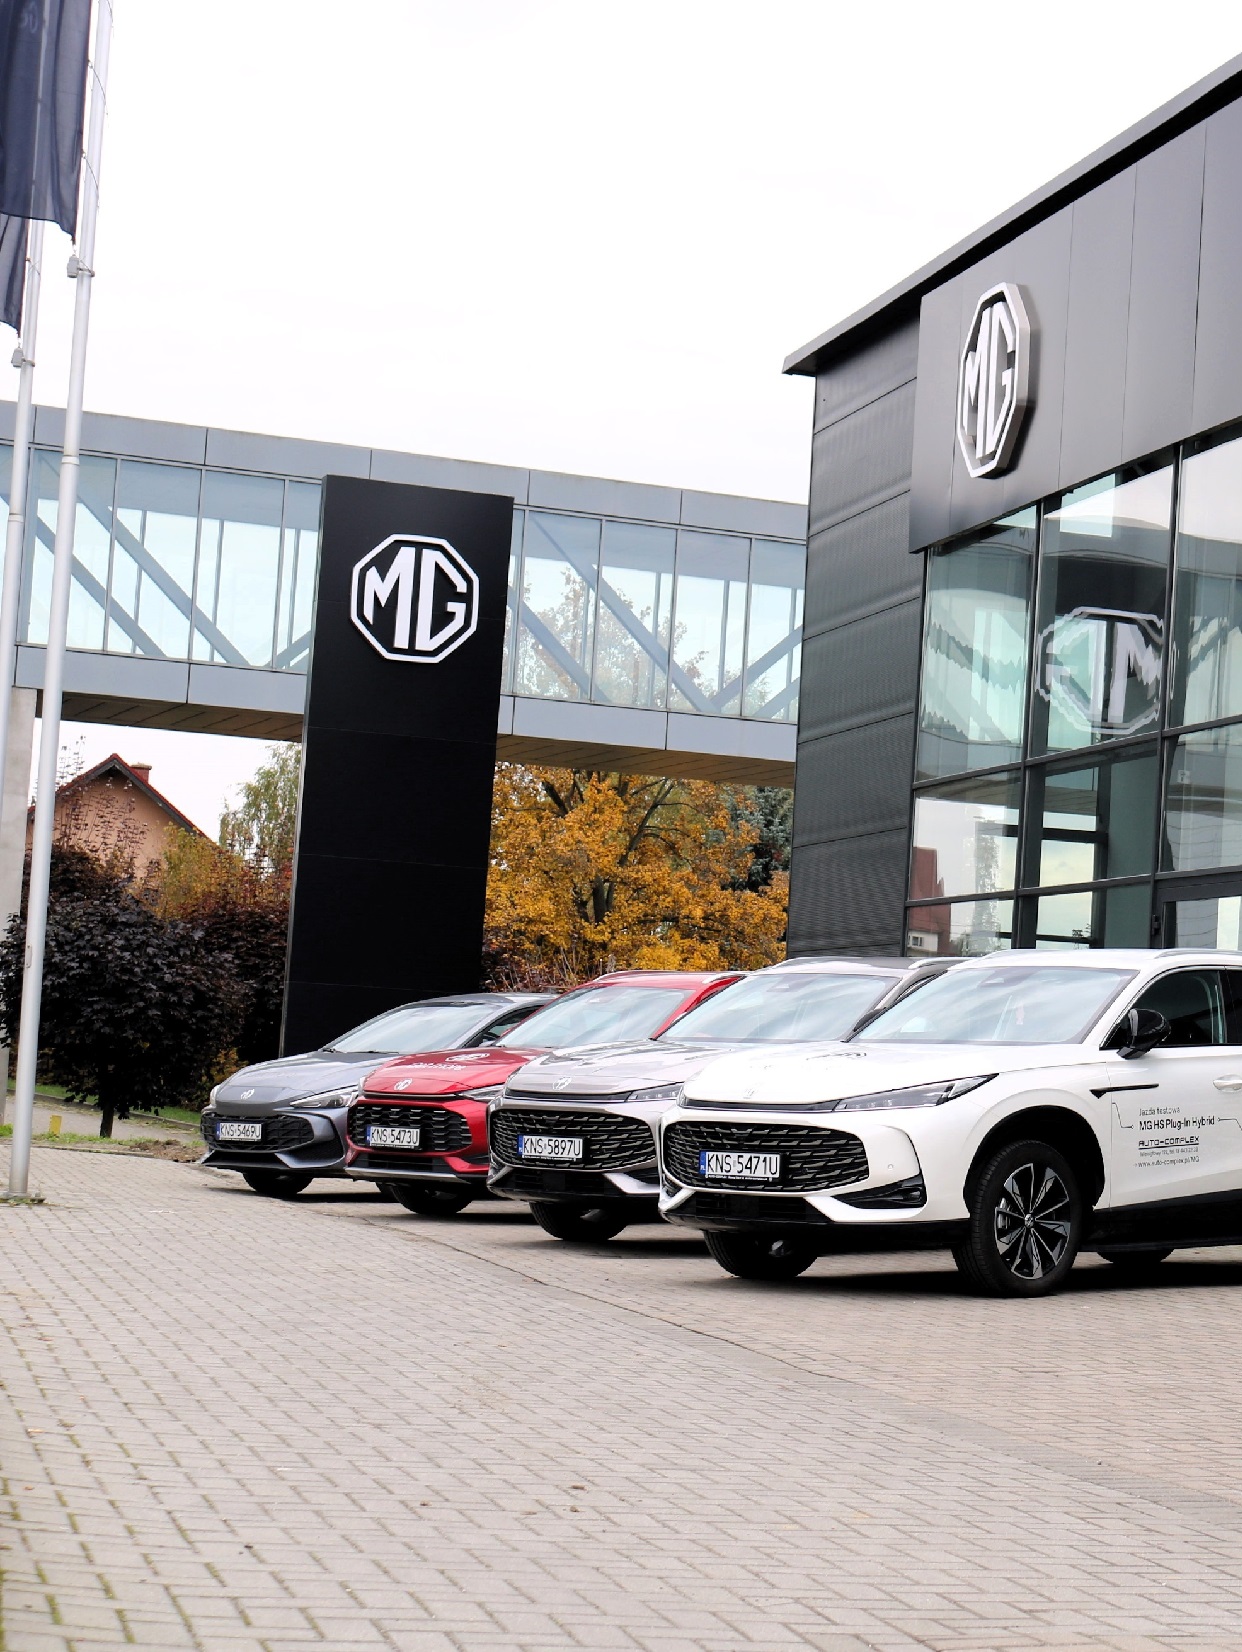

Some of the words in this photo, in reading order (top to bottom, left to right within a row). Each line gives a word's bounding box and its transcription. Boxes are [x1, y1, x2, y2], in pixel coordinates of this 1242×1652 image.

[962, 300, 1016, 460] MG
[363, 546, 468, 652] MG
[220, 1124, 235, 1137] KNS
[1139, 1120, 1153, 1131] MG
[1153, 1119, 1165, 1130] HS
[1165, 1117, 1191, 1131] Plug-In
[1191, 1115, 1215, 1129] Hybrid
[371, 1128, 388, 1143] KNS
[390, 1129, 419, 1144] 5473U
[1138, 1135, 1200, 1147] AUTO-COMPLEX
[523, 1138, 544, 1154] KNS
[547, 1138, 581, 1156] 5897U
[707, 1153, 732, 1173] KNS
[736, 1154, 778, 1175] 5471U
